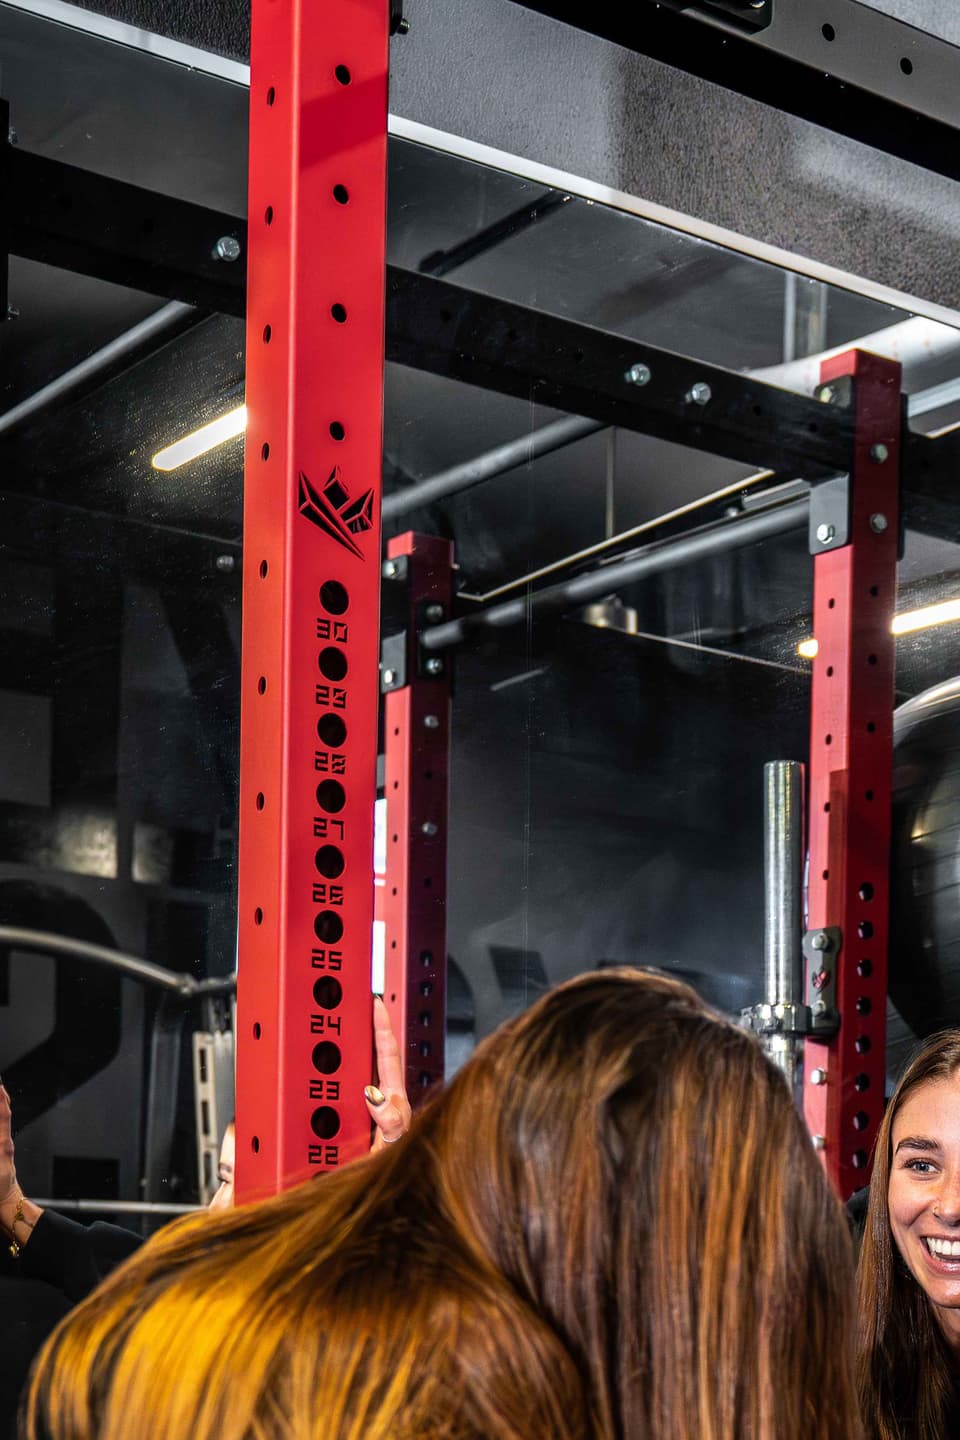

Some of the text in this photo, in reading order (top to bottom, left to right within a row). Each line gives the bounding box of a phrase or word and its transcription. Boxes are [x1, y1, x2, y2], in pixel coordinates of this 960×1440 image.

[317, 618, 348, 643] 30
[316, 685, 346, 709] 29
[315, 751, 345, 775] 28
[314, 817, 344, 840] 27
[313, 883, 343, 905] 26
[312, 949, 342, 971] 25
[311, 1014, 341, 1036] 24
[310, 1080, 340, 1100] 23
[308, 1144, 338, 1165] 22
